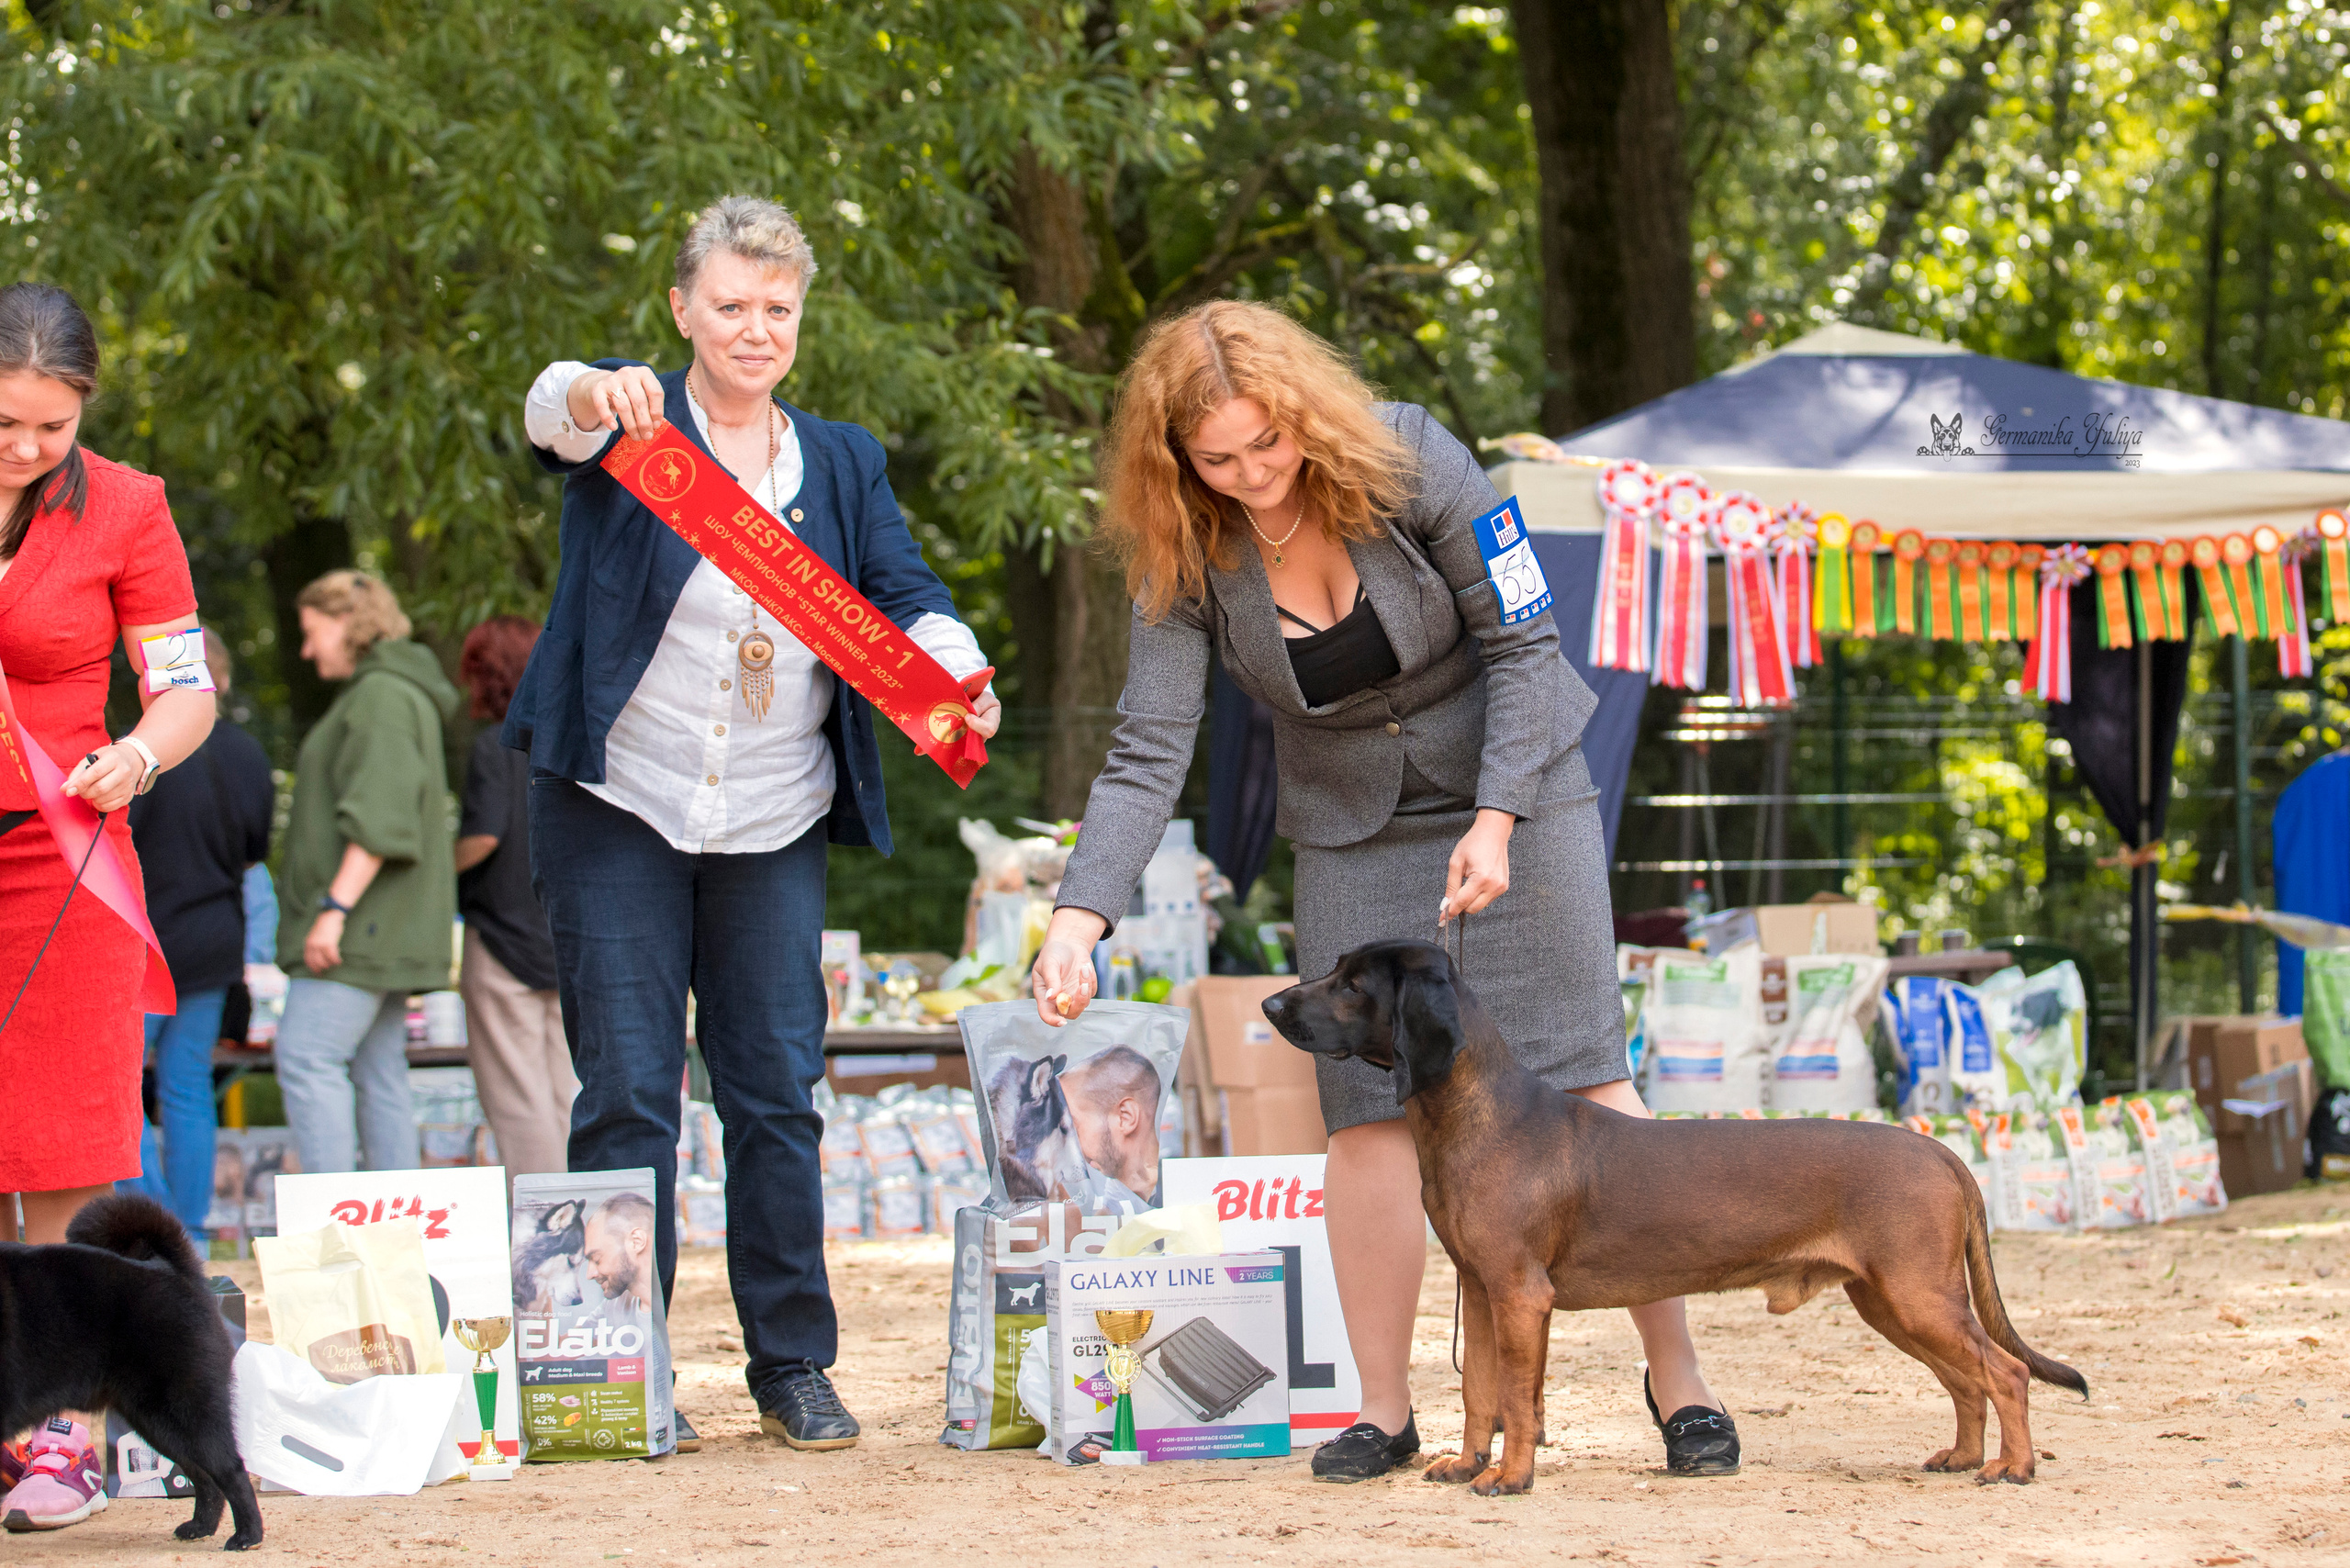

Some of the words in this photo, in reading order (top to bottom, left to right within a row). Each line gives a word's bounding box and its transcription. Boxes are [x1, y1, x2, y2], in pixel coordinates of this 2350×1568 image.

[1498, 523, 1518, 547] Hill's
[703, 514, 733, 540] ШОУ
[732, 537, 797, 599] ЧЕМПИОНОВ
[825, 622, 867, 663] WINNER
[732, 504, 794, 557] BEST
[786, 554, 820, 584] IN
[813, 578, 890, 644] SHOW
[885, 644, 894, 654] -
[896, 651, 914, 669] 1
[730, 566, 759, 594] МКОО
[804, 635, 811, 644] г.
[812, 641, 845, 672] Москва
[166, 634, 194, 672] 2
[171, 676, 199, 685] bosch
[1212, 1175, 1325, 1222] Blitz
[1070, 1270, 1158, 1290] GALAXY
[1169, 1268, 1215, 1286] LINE
[1247, 1271, 1274, 1280] YEARS
[519, 1316, 644, 1358] Eláto
[532, 1393, 556, 1403] 58%
[1091, 1382, 1111, 1391] 850
[533, 1415, 557, 1425] 42%
